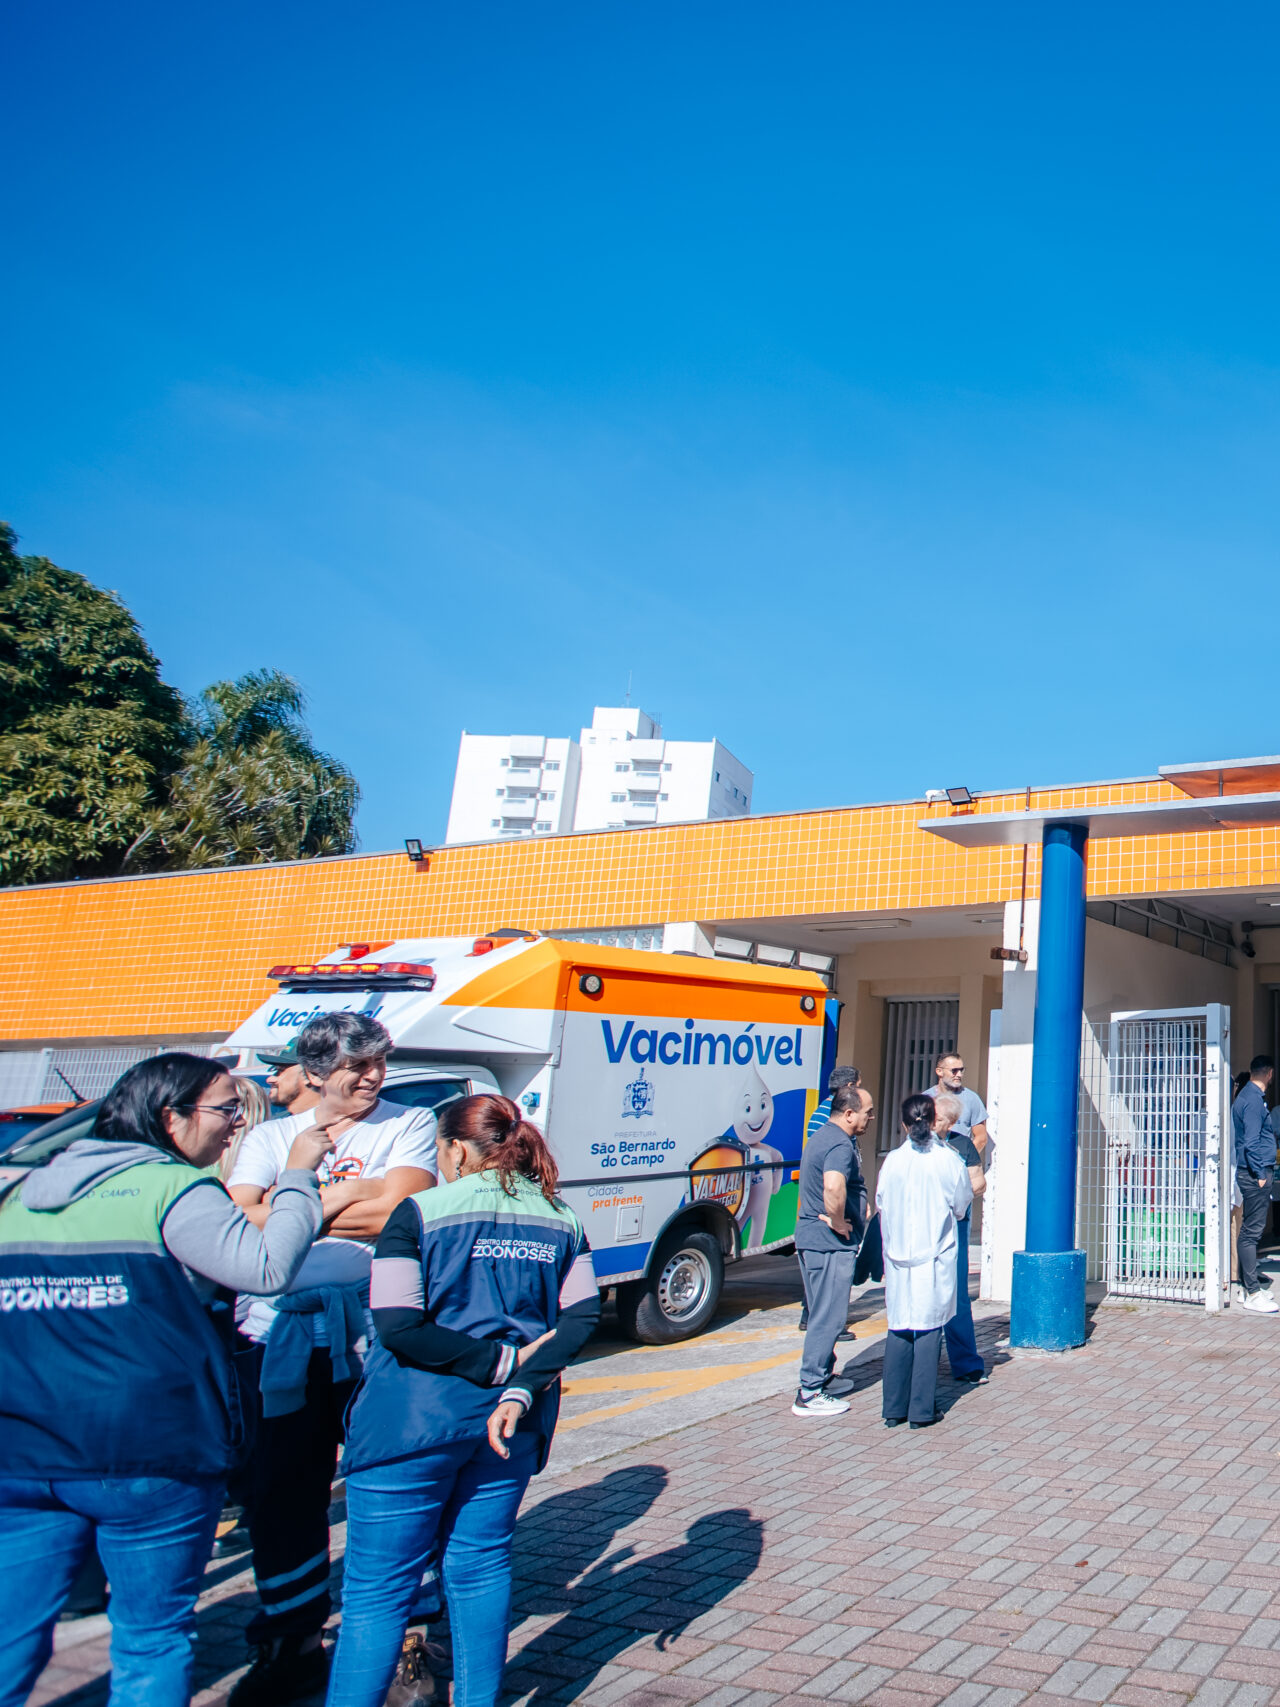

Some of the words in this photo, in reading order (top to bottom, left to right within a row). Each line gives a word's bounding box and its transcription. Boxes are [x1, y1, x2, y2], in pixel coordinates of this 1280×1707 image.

[600, 1018, 803, 1067] Vacimóvel
[614, 1130, 657, 1138] PREFEITURA
[590, 1142, 616, 1155] São
[618, 1138, 676, 1153] Bernardo
[601, 1155, 617, 1168] do
[621, 1154, 664, 1168] Campo
[587, 1185, 624, 1197] Cidade
[592, 1199, 611, 1212] pra
[613, 1195, 643, 1207] frente
[476, 1238, 500, 1246] CENTRO
[501, 1239, 512, 1247] DE
[512, 1240, 547, 1250] CONTROLE
[547, 1243, 557, 1251] DE
[472, 1245, 556, 1264] ZOONOSES
[47, 1276, 104, 1287] CONTROLE
[105, 1275, 123, 1285] DE
[0, 1285, 129, 1312] OONOSES
